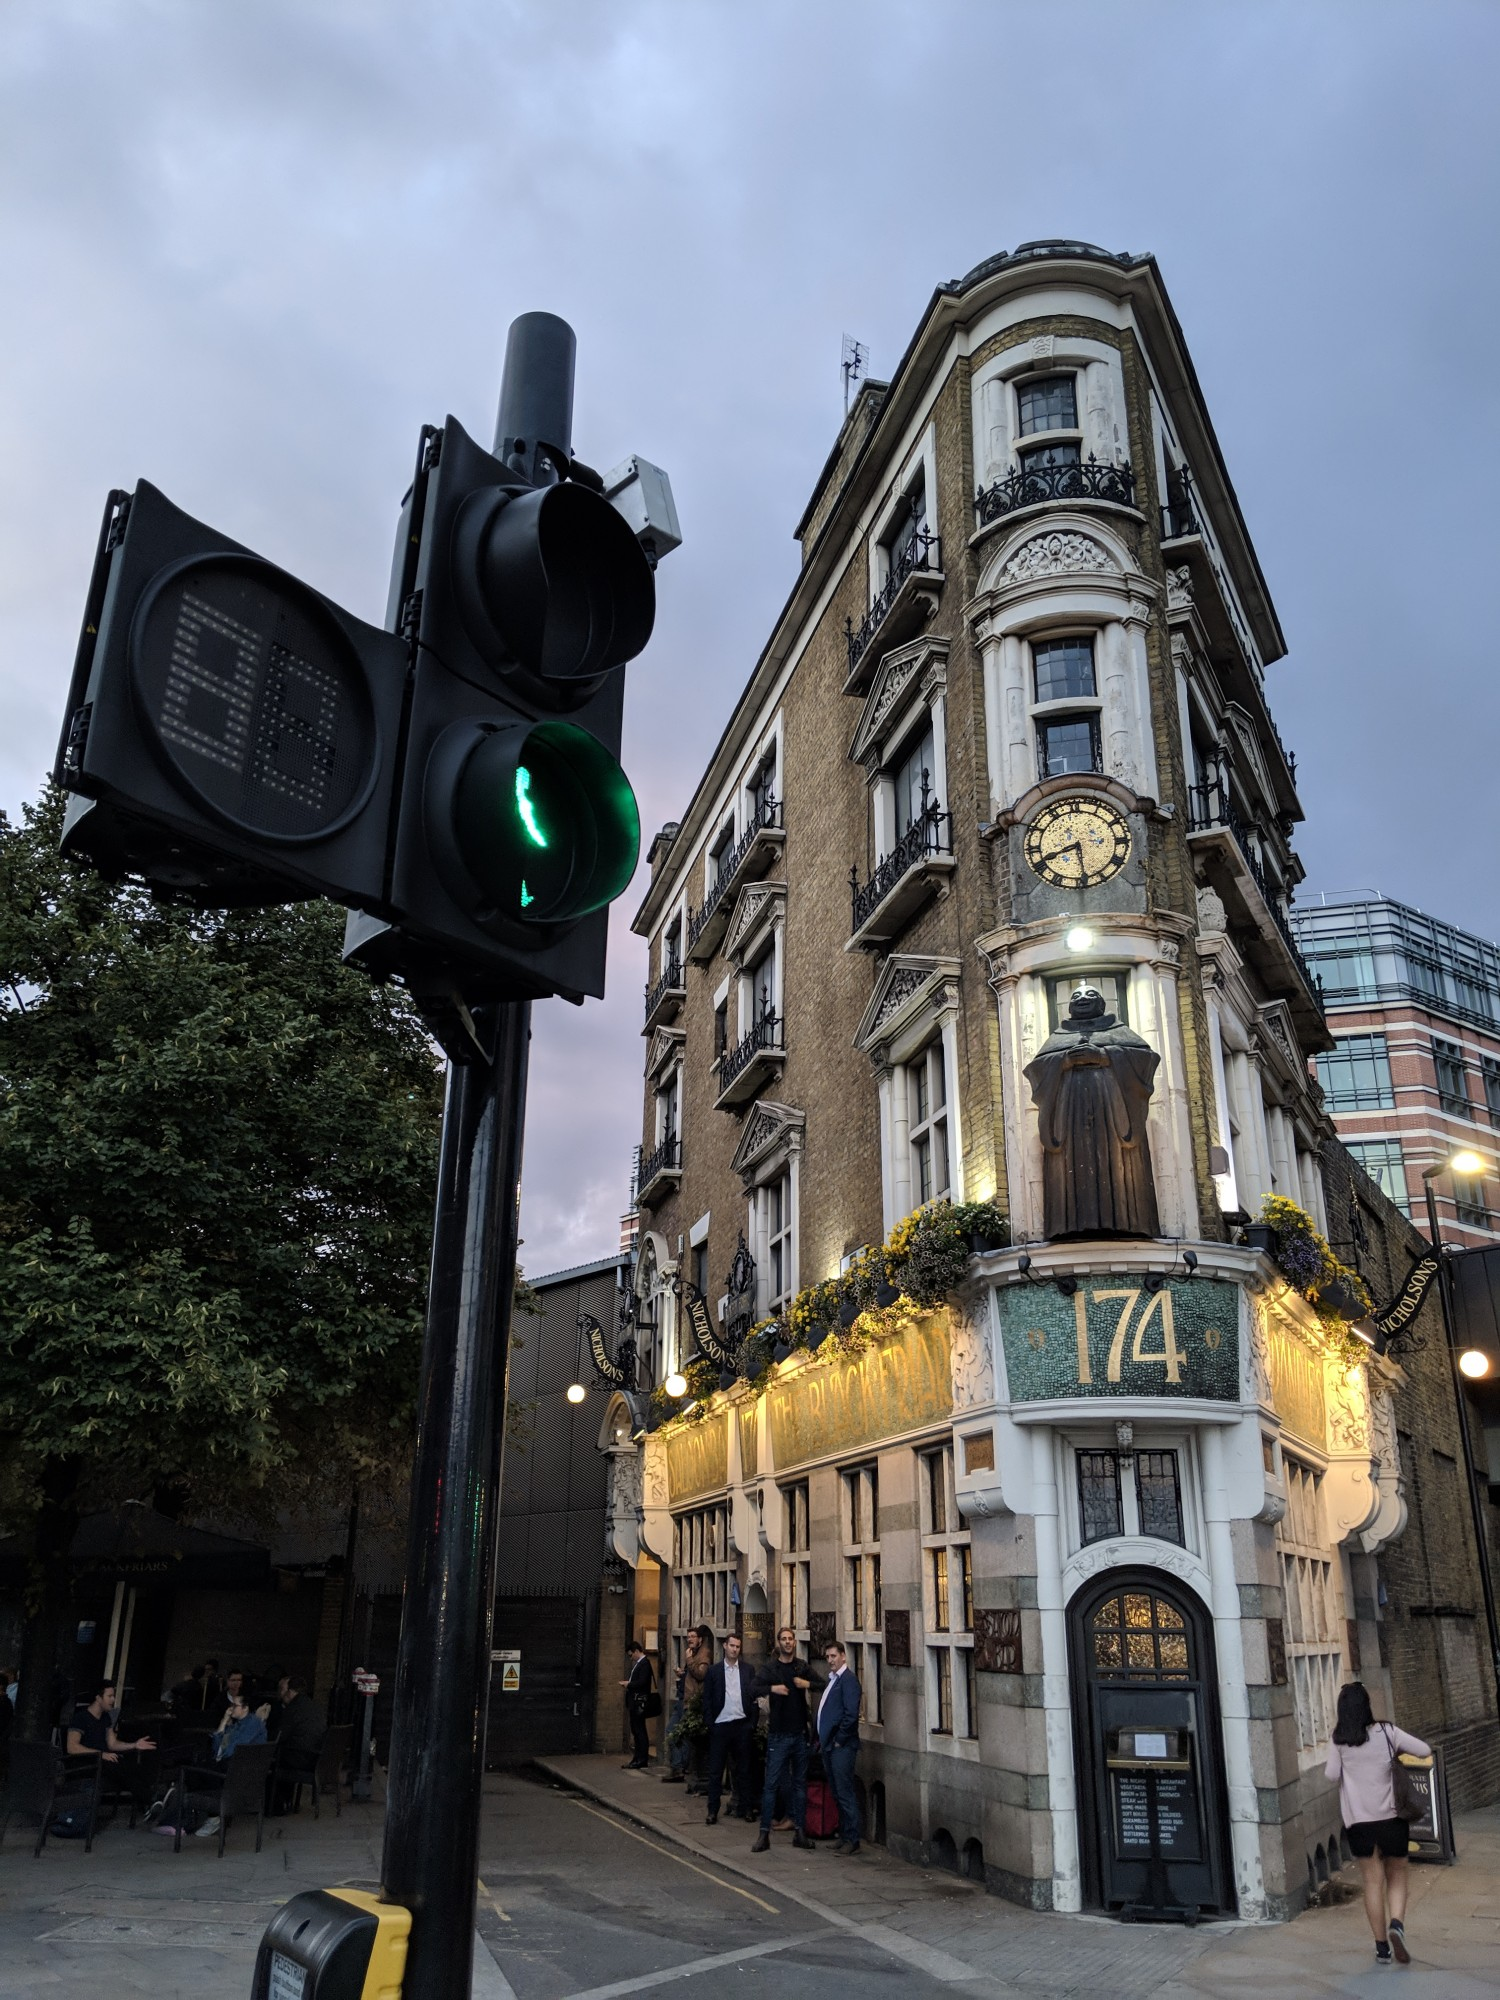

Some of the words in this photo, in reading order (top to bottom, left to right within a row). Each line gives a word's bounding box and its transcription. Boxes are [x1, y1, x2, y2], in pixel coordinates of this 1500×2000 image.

[1376, 1257, 1438, 1335] NICHOLSON'S
[589, 1327, 624, 1382] NICHOLSON'S
[1075, 1288, 1187, 1385] 174
